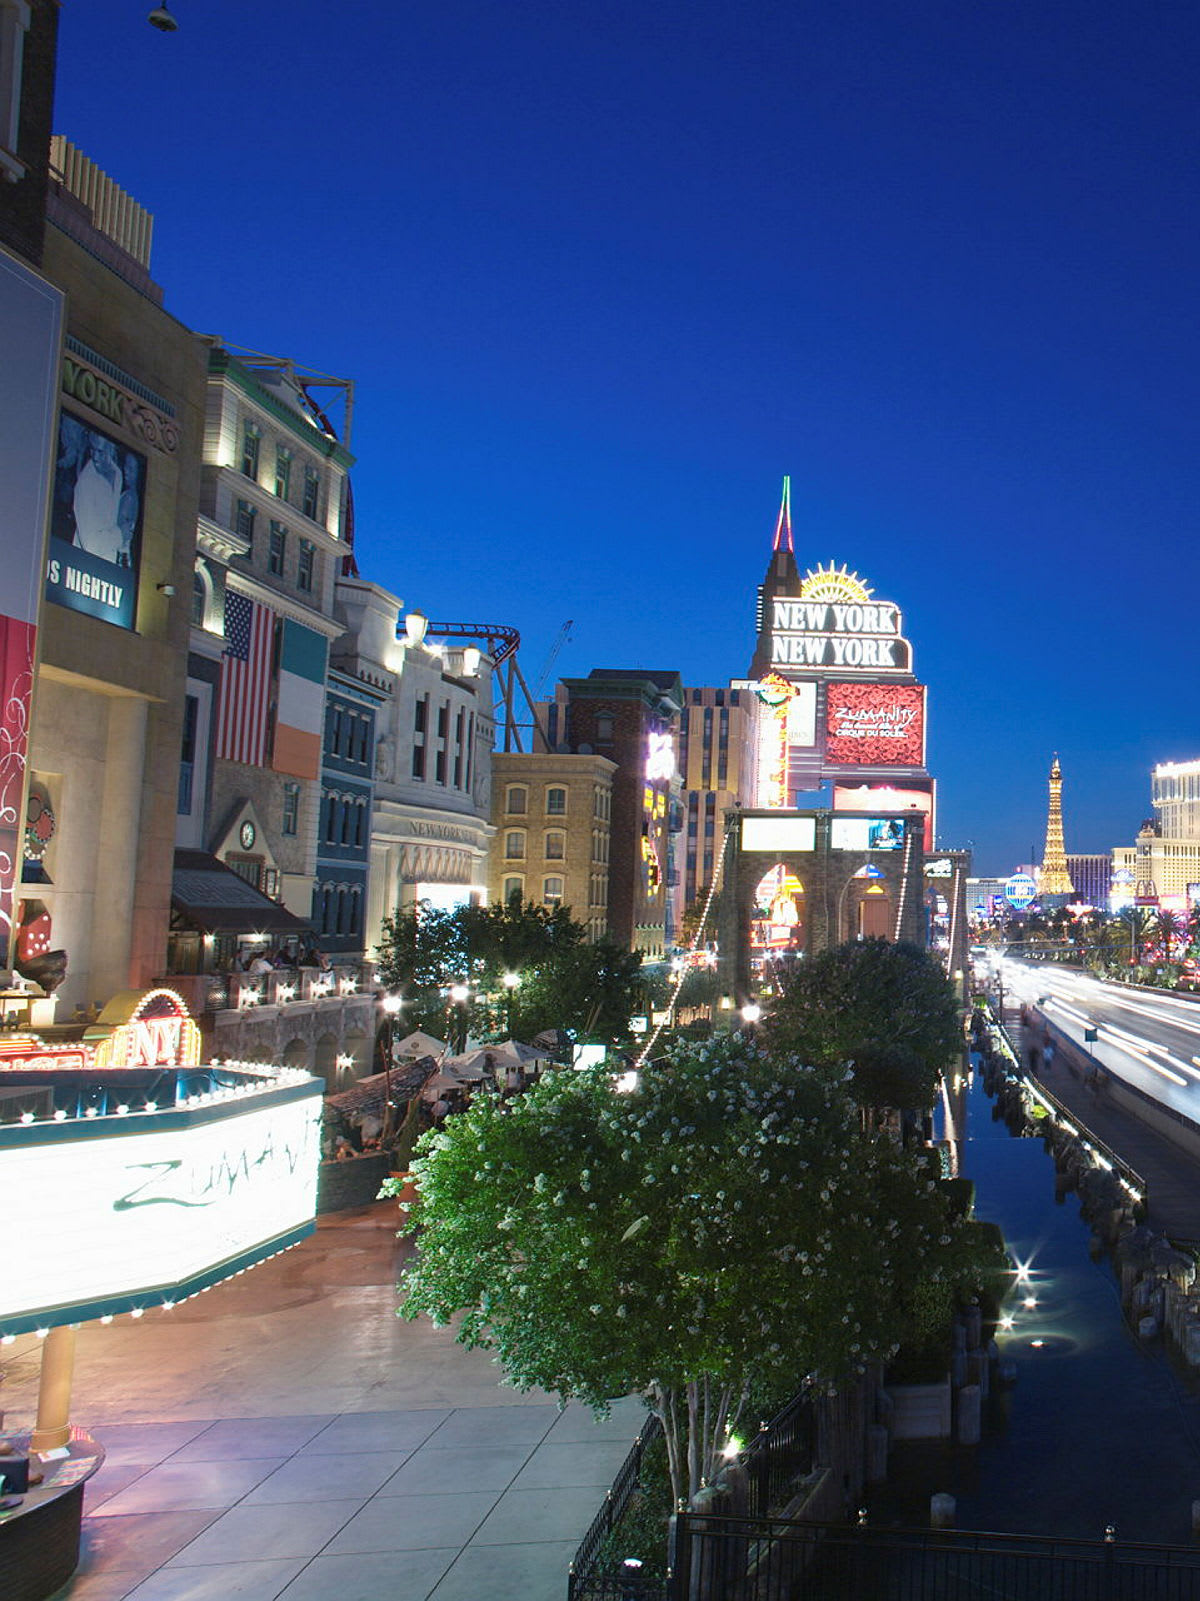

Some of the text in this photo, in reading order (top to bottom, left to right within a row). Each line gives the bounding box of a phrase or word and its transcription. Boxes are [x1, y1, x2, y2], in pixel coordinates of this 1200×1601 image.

[62, 359, 123, 421] YORK
[65, 566, 123, 609] NIGHTLY
[773, 601, 896, 633] NEW YORK
[771, 635, 896, 667] NEW YORK
[835, 704, 918, 726] ZUMANITY
[410, 821, 435, 836] NEW
[136, 1016, 183, 1065] NY
